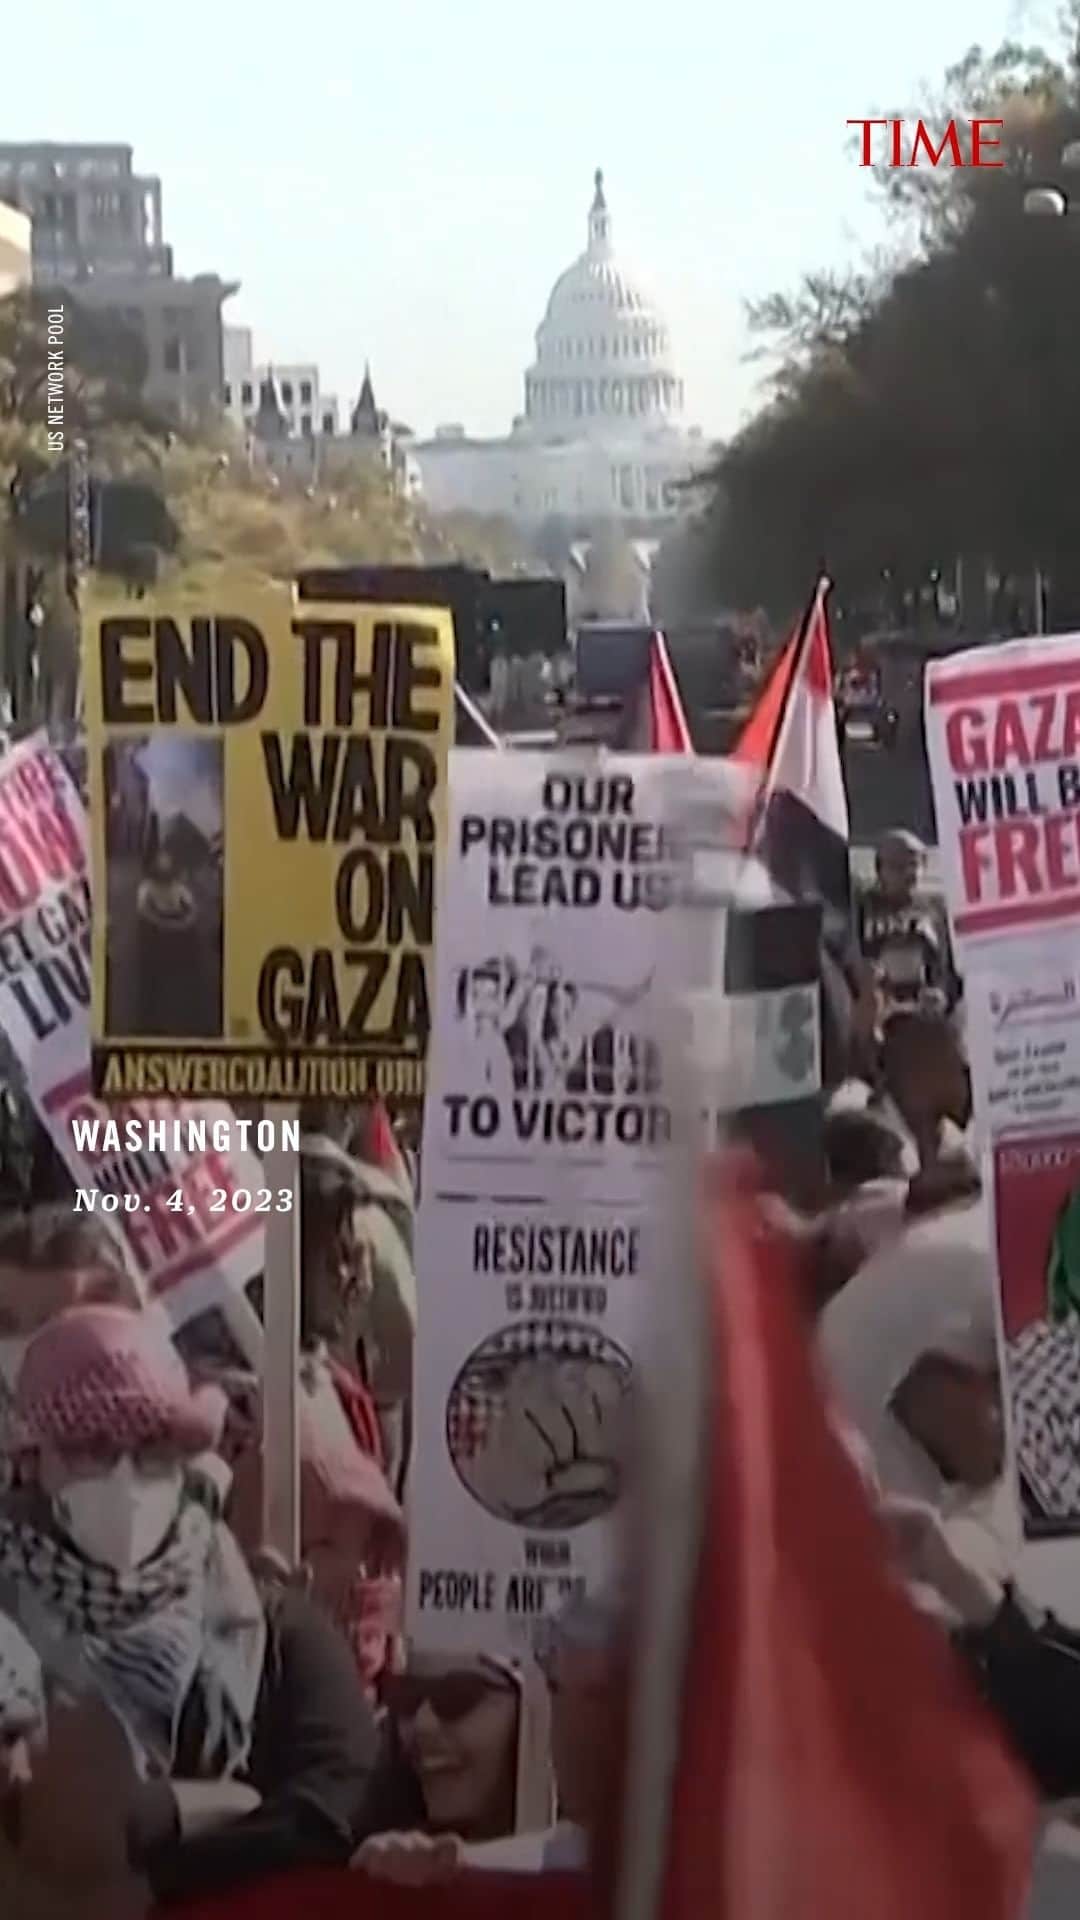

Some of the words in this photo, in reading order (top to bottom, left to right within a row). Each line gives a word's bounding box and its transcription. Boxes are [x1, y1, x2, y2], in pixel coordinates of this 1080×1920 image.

[101, 616, 269, 724] END
[291, 620, 441, 731] THE
[262, 732, 437, 843] WAR
[543, 774, 634, 816] OUR
[955, 772, 1047, 823] WILL
[460, 816, 664, 862] PRISONE
[960, 810, 1080, 904] FRE
[335, 849, 434, 945] ON
[488, 864, 598, 907] LEAD
[9, 940, 93, 1041] LIV
[257, 947, 431, 1045] GAZA
[443, 1096, 500, 1140] TO
[419, 1569, 496, 1612] PEOPLE
